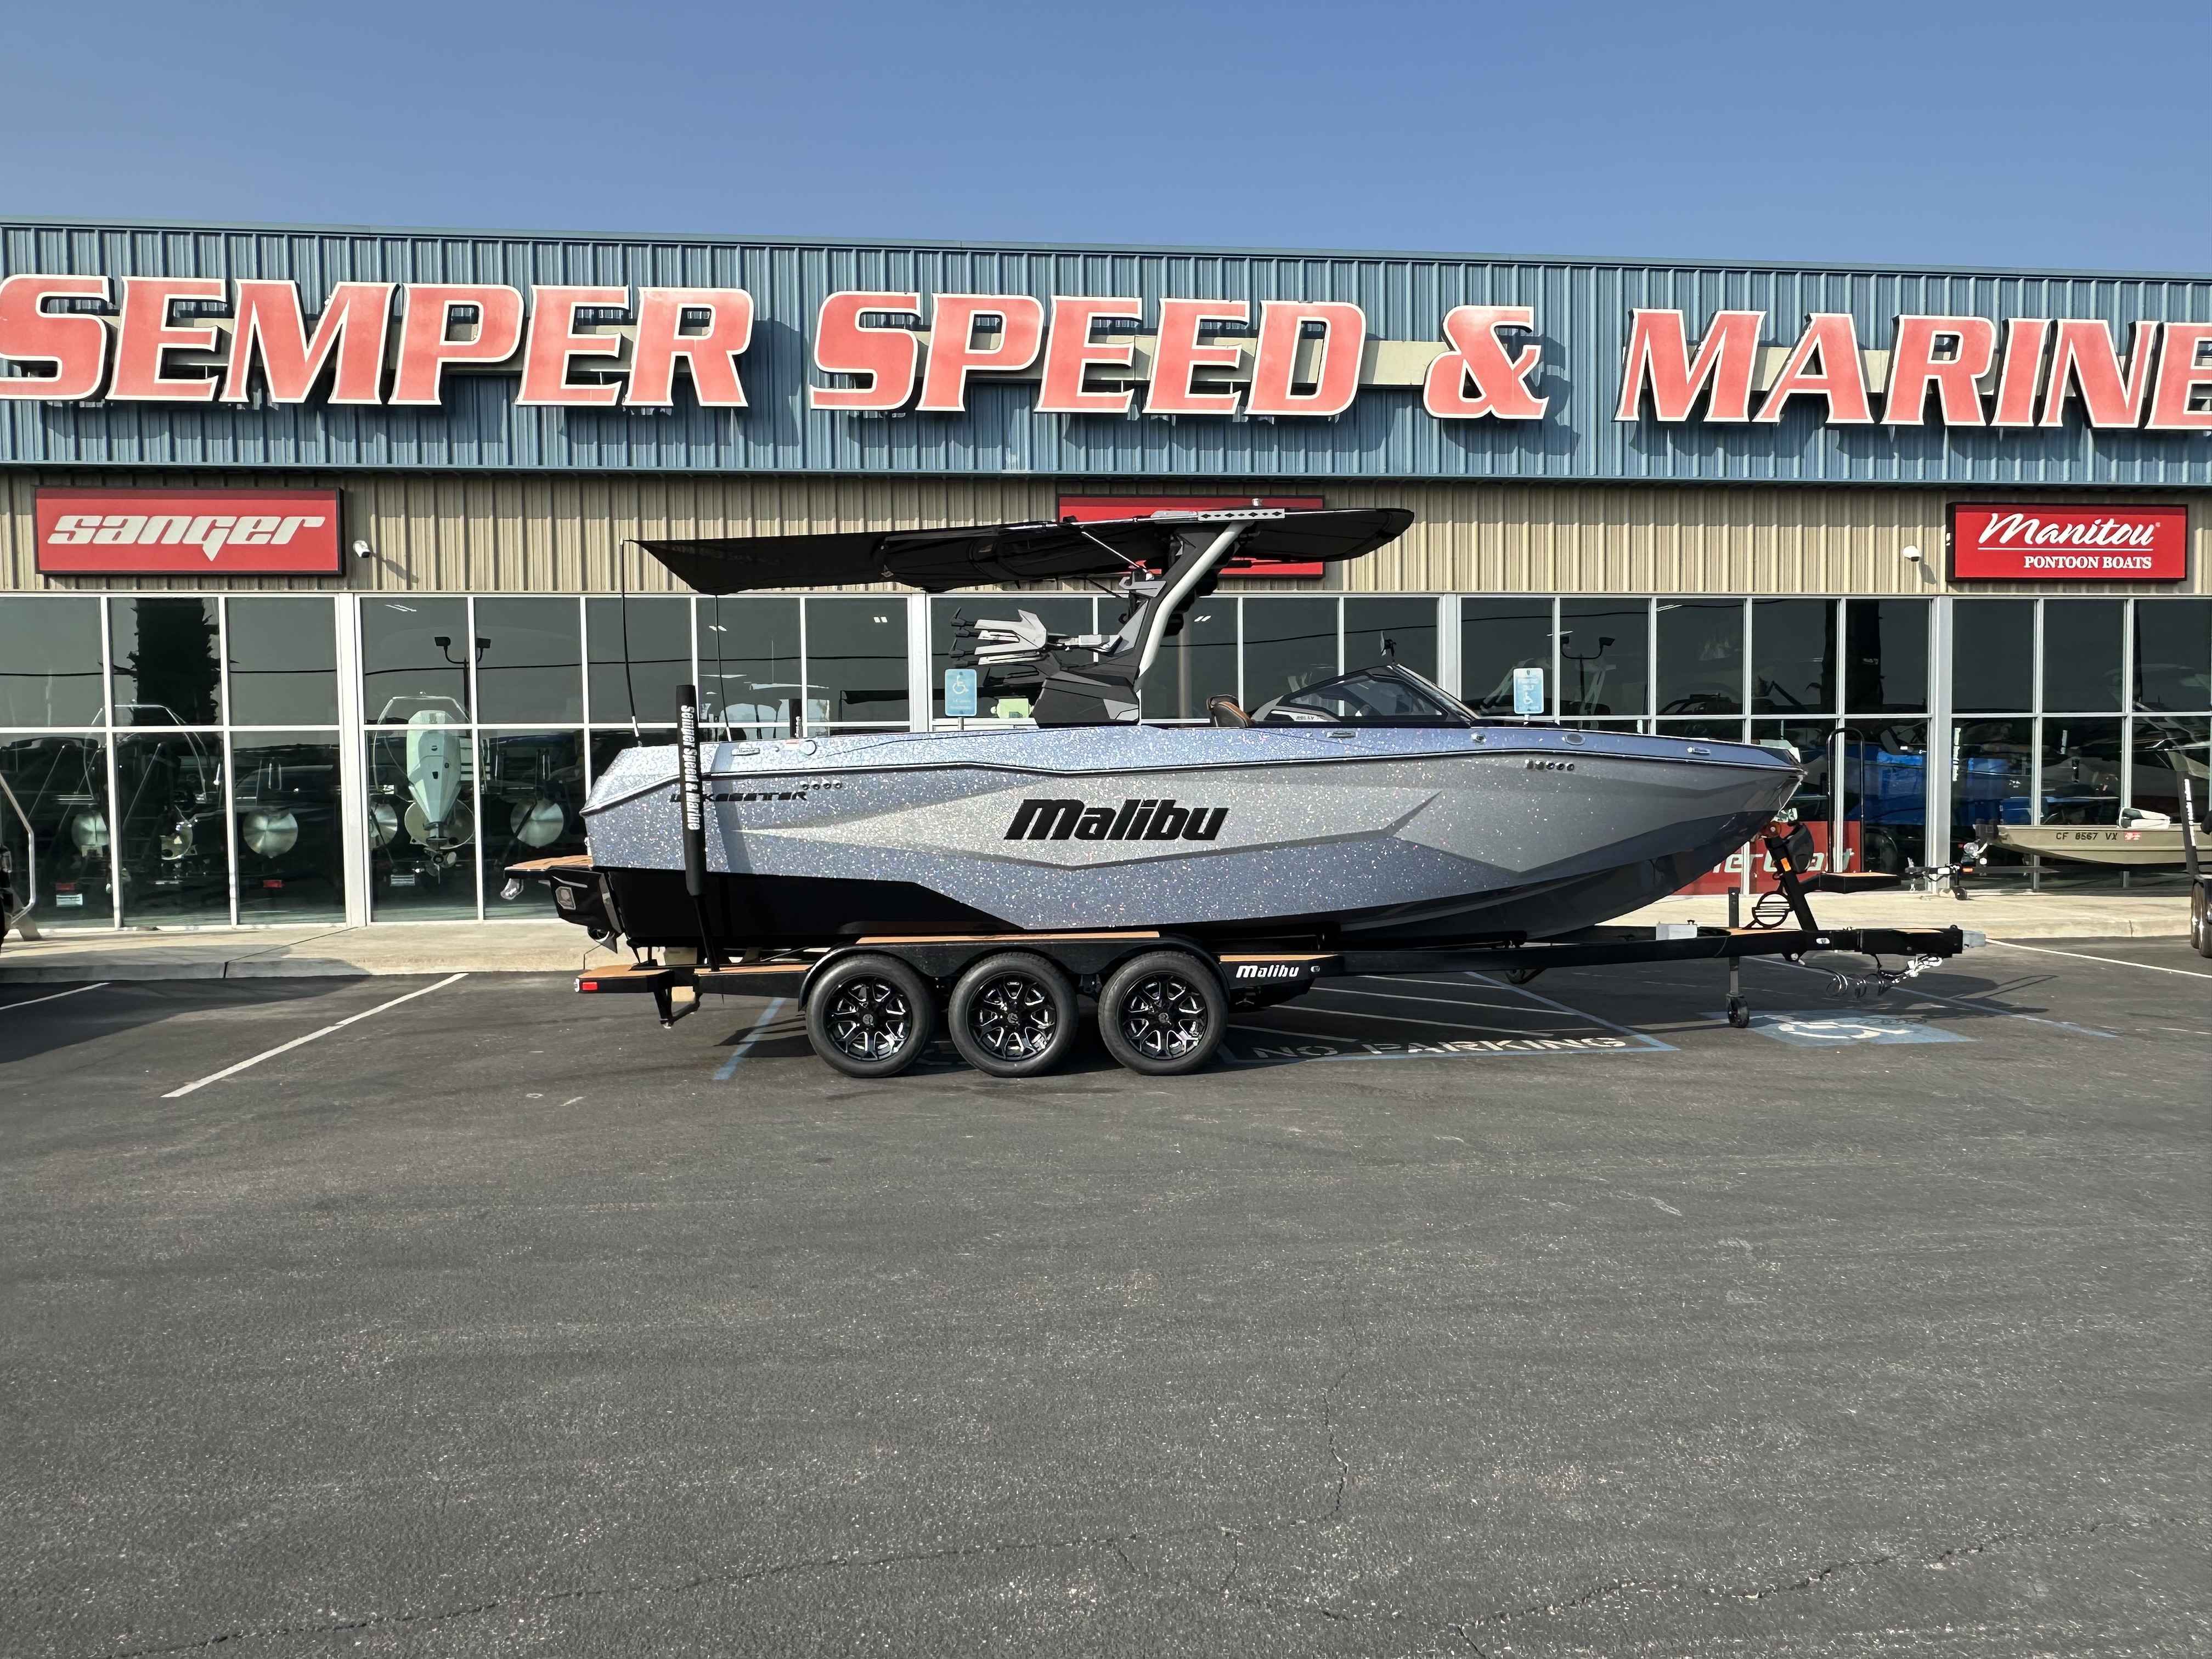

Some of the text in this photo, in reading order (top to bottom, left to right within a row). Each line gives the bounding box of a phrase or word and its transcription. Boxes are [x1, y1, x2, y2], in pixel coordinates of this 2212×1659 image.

[0, 274, 2212, 430] SEMPER SPEED & MARINE
[47, 515, 325, 562] sanger
[1978, 513, 2154, 546] Manitou
[2023, 556, 2152, 569] PONTOON BOATS
[1003, 799, 1229, 840] Malibu
[2056, 832, 2069, 840] CF
[1235, 964, 1300, 979] Malibu
[1250, 1036, 1626, 1058] NO PARKING
